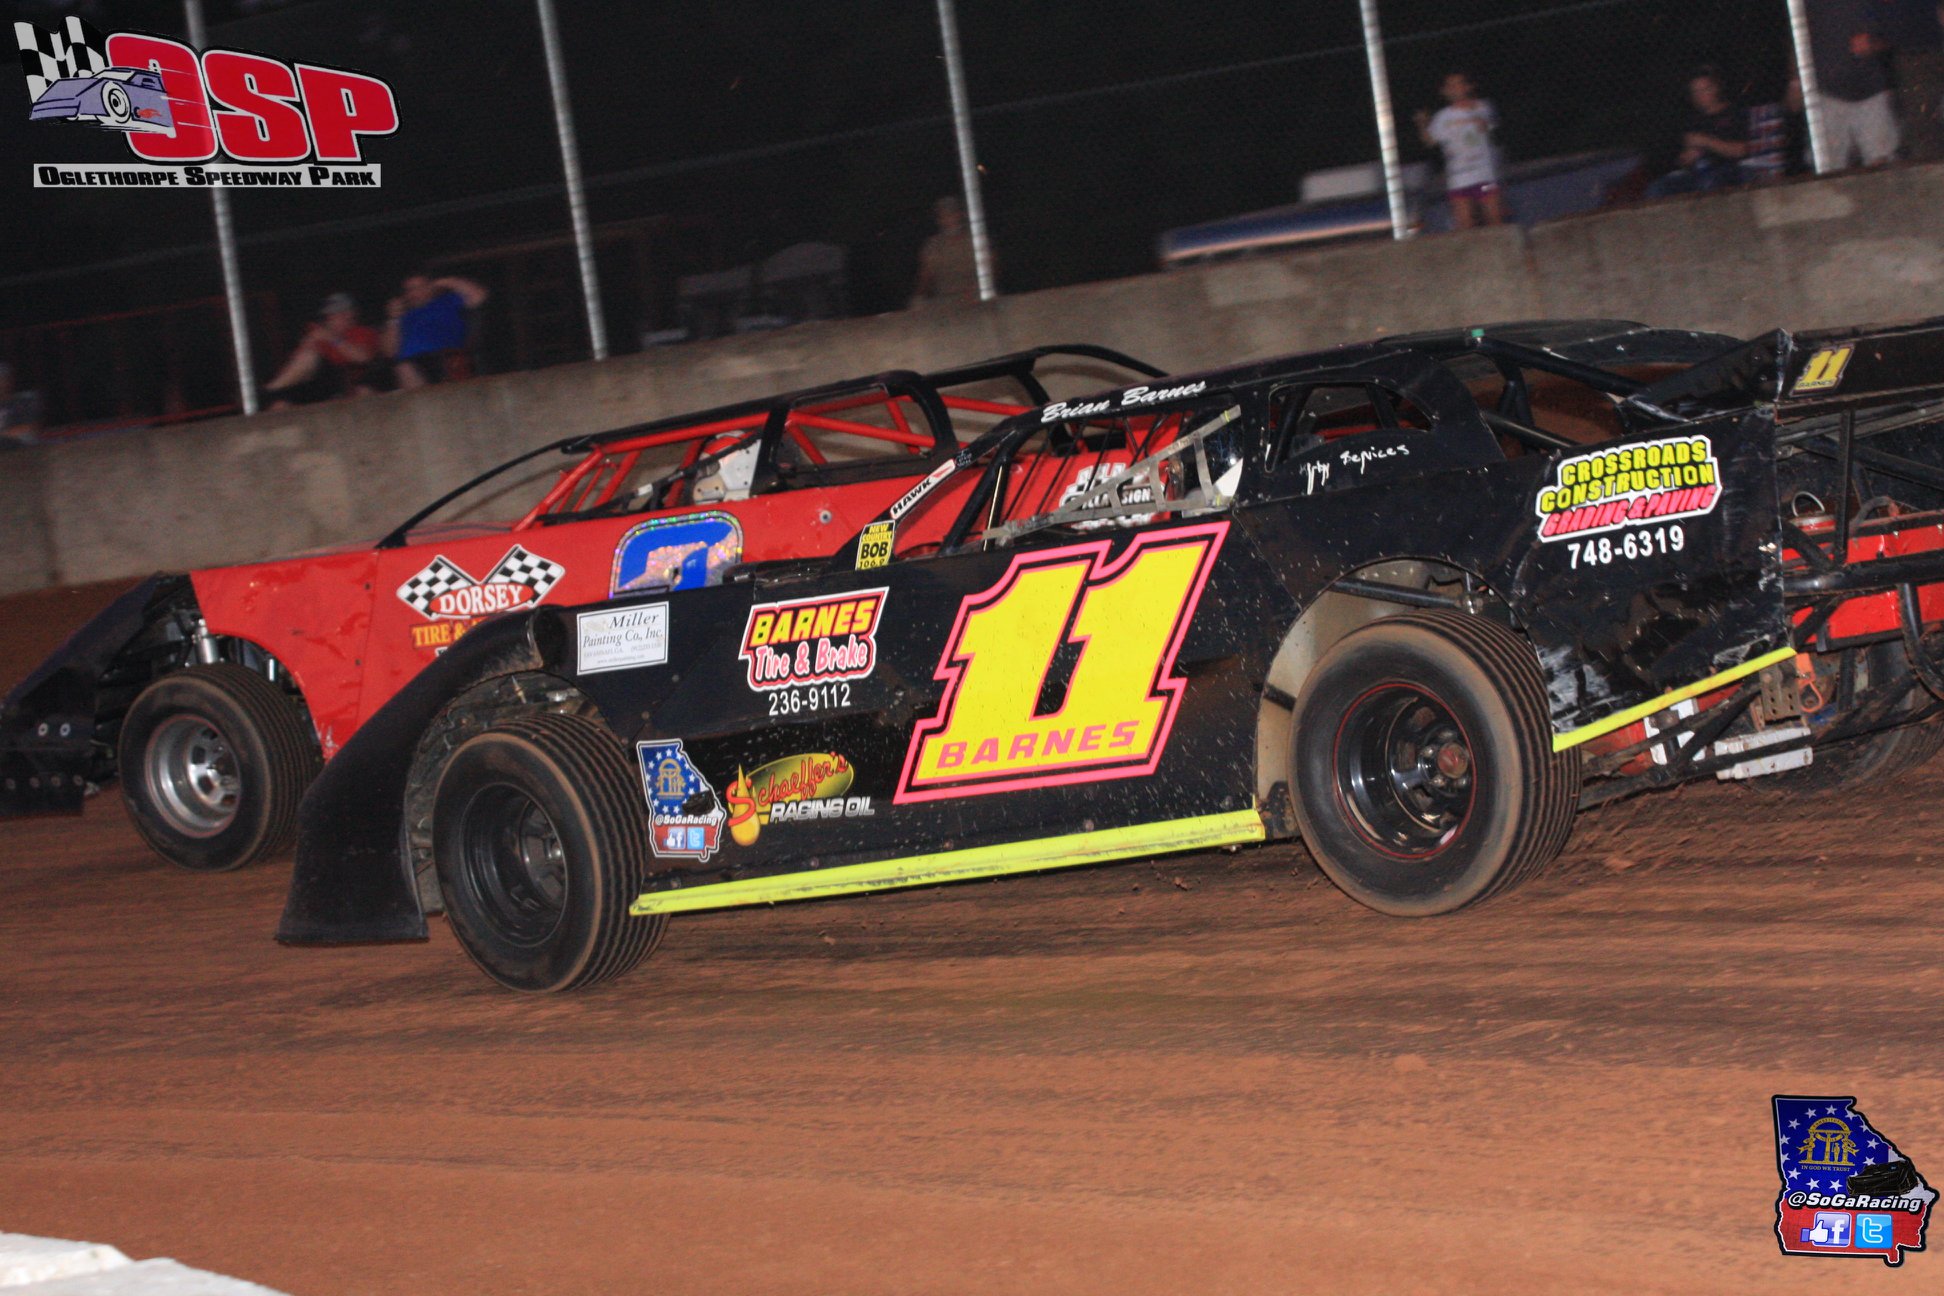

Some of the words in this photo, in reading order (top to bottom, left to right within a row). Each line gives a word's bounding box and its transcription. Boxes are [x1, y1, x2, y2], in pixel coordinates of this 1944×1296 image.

[1796, 346, 1852, 390] 11
[1041, 400, 1110, 423] Brian
[1121, 381, 1207, 406] Barnes
[1561, 439, 1707, 486] CROSSROADS
[892, 478, 931, 515] HAWK
[1540, 463, 1715, 513] CONSTRUCTION
[869, 523, 890, 533] NEW
[1542, 499, 1630, 537] GRADING
[1627, 496, 1647, 520] &
[1644, 485, 1717, 518] PAVING
[861, 542, 888, 560] BOB
[1567, 525, 1684, 569] 748-6319
[440, 584, 522, 615] DORSEY
[412, 623, 450, 646] TIRE
[583, 631, 622, 648] Painting
[646, 627, 663, 639] Inc.
[610, 611, 659, 629] Miller
[749, 598, 876, 648] BARNES
[755, 645, 789, 681] Tire
[794, 640, 810, 672] &
[814, 634, 867, 672] Brake
[912, 540, 1212, 786] 11
[768, 683, 851, 716] 236-9112
[936, 720, 1140, 769] BARNES
[655, 815, 717, 826] @SoGaRacing
[769, 800, 844, 823] RACING
[845, 796, 876, 817] OIL
